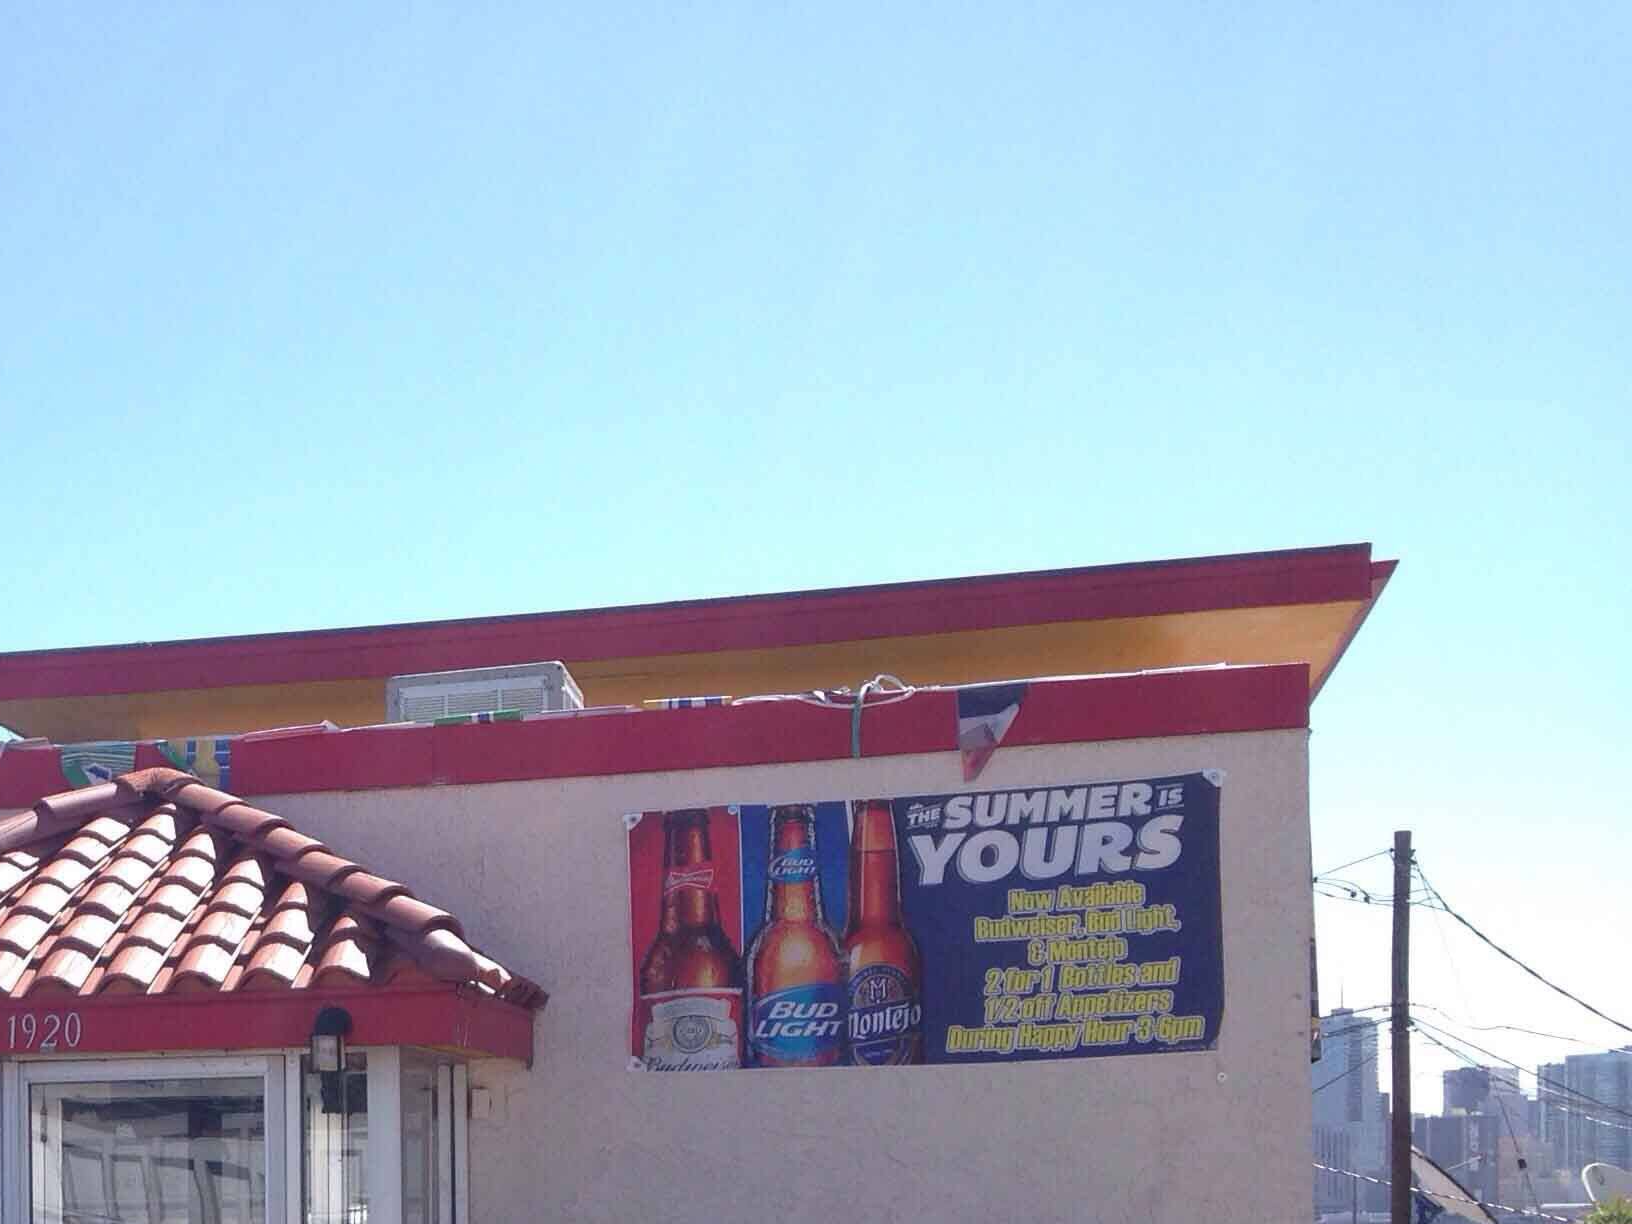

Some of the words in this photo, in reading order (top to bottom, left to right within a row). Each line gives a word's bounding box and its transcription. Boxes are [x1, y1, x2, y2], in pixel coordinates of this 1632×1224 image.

[906, 808, 941, 826] THE
[944, 783, 1153, 830] SUMMER
[1159, 786, 1183, 807] IS
[910, 815, 1185, 886] YOURS
[1056, 880, 1146, 910] Available
[1048, 936, 1128, 962] Montejo
[984, 968, 1002, 995] 2
[1138, 956, 1181, 984] and
[768, 1001, 839, 1019] BUD
[1055, 989, 1174, 1018] Appetizers
[7, 1012, 81, 1049] 1920
[755, 1020, 842, 1038] LIGHT
[1017, 1022, 1081, 1051] Happy
